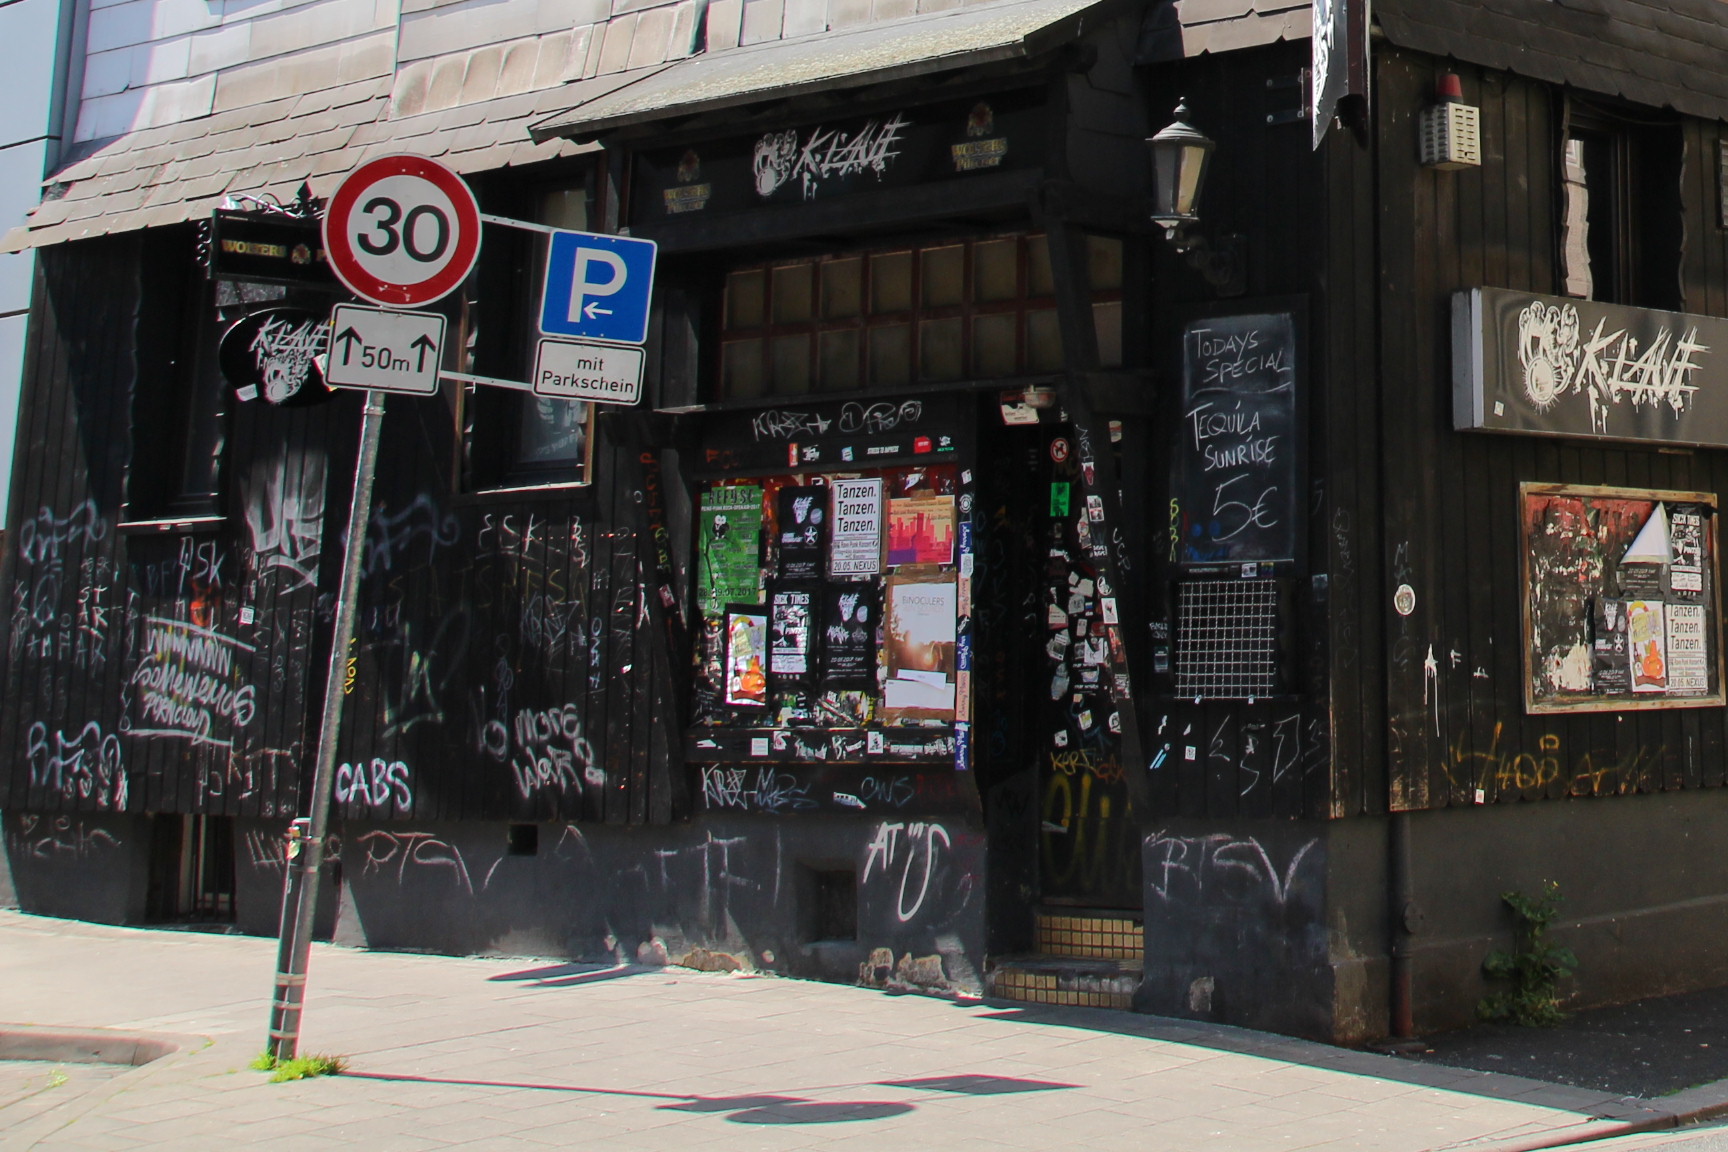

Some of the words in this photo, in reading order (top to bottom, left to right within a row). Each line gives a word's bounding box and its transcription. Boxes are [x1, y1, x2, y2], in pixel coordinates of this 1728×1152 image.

[357, 196, 450, 263] 30
[567, 247, 628, 323] P
[1191, 328, 1259, 362] TODAYS
[577, 356, 604, 372] mit
[1203, 347, 1291, 383] SPECIAL
[541, 371, 634, 394] Parkschein
[1185, 400, 1260, 451] TEQUILA
[1204, 435, 1280, 472] SUNRISE
[837, 484, 877, 499] Tanzen.
[837, 501, 876, 515] Tanzen.
[1212, 473, 1278, 542] 5€
[837, 517, 876, 532] Tanzen.
[853, 560, 877, 571] NEXUS
[1669, 619, 1701, 633] Tanzen.
[1670, 635, 1702, 650] Tanzen.
